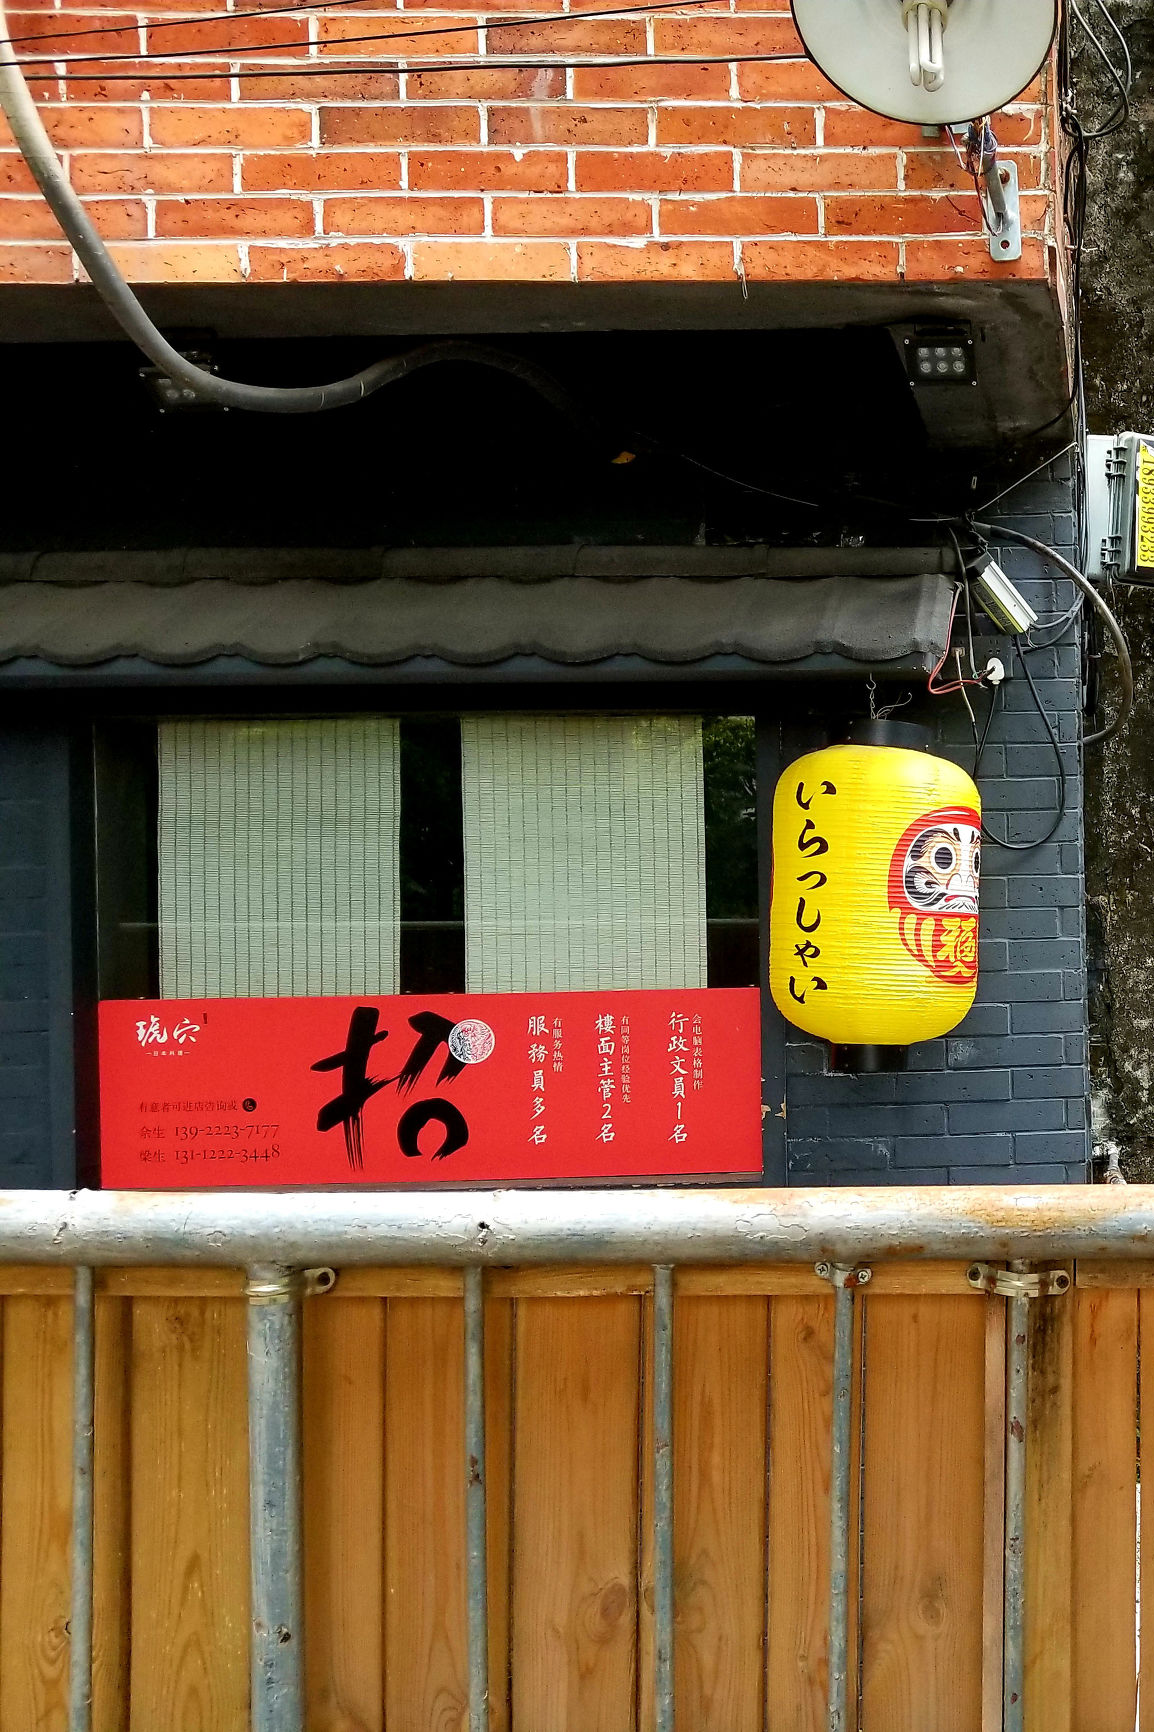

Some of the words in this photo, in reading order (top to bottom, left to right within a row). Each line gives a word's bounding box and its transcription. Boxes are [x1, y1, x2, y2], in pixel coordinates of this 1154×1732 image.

[788, 781, 837, 1005] いらっしゃい
[527, 1015, 550, 1145] 服務員多名
[552, 1017, 564, 1073] 有服务热情
[595, 1013, 617, 1144] 樓面主管2名
[667, 1011, 690, 1144] 行政文員1名
[692, 1013, 704, 1091] 会电脑表格制作
[175, 1124, 280, 1141] 139-2223-7177
[175, 1144, 280, 1165] 131-1222-3448
